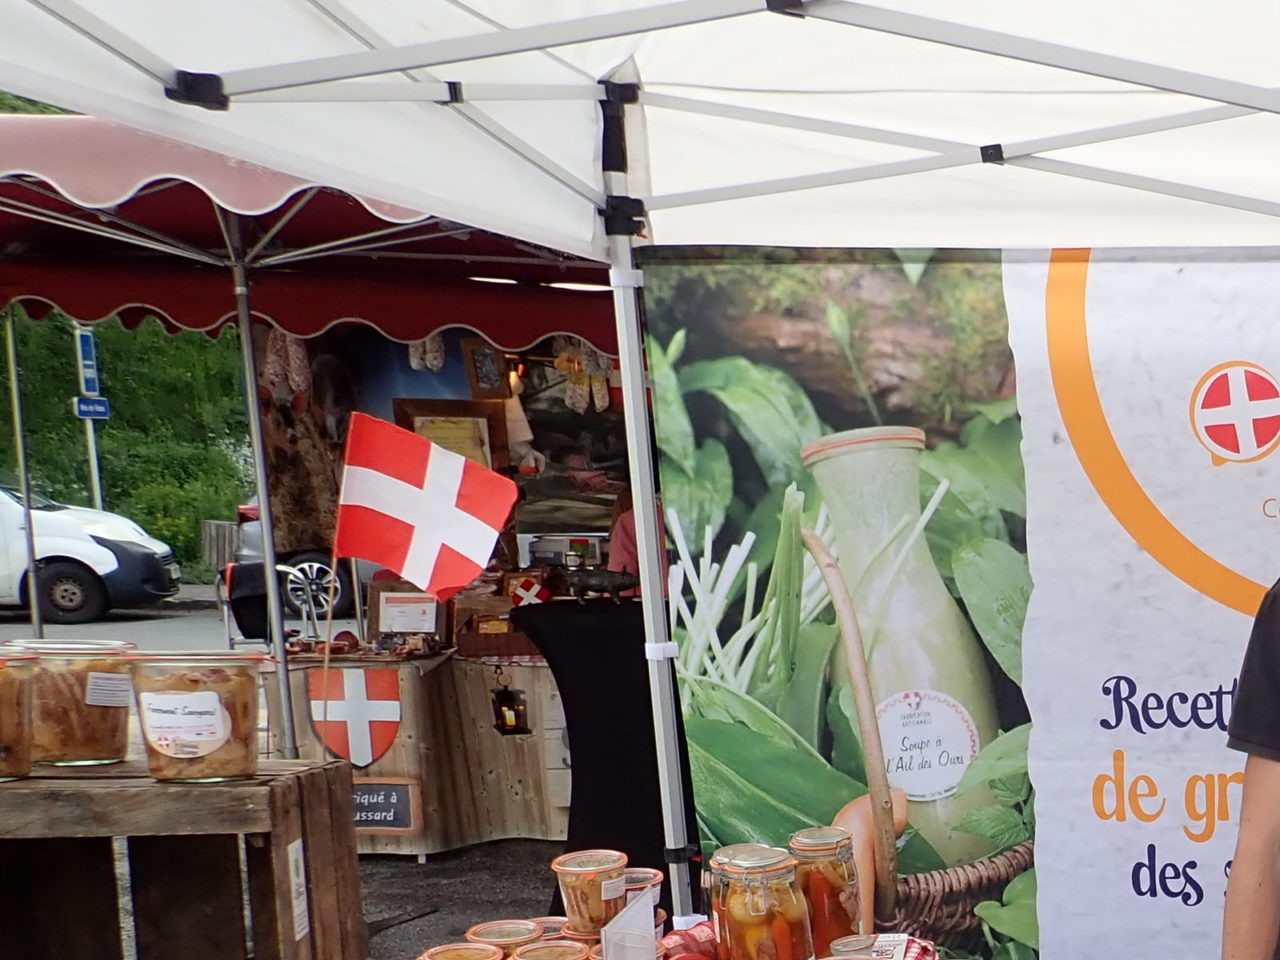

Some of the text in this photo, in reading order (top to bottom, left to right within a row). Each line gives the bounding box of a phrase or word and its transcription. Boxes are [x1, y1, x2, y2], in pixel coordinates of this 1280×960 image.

[900, 736, 930, 754] Soupe
[1092, 749, 1166, 823] de
[1131, 843, 1204, 907] des
